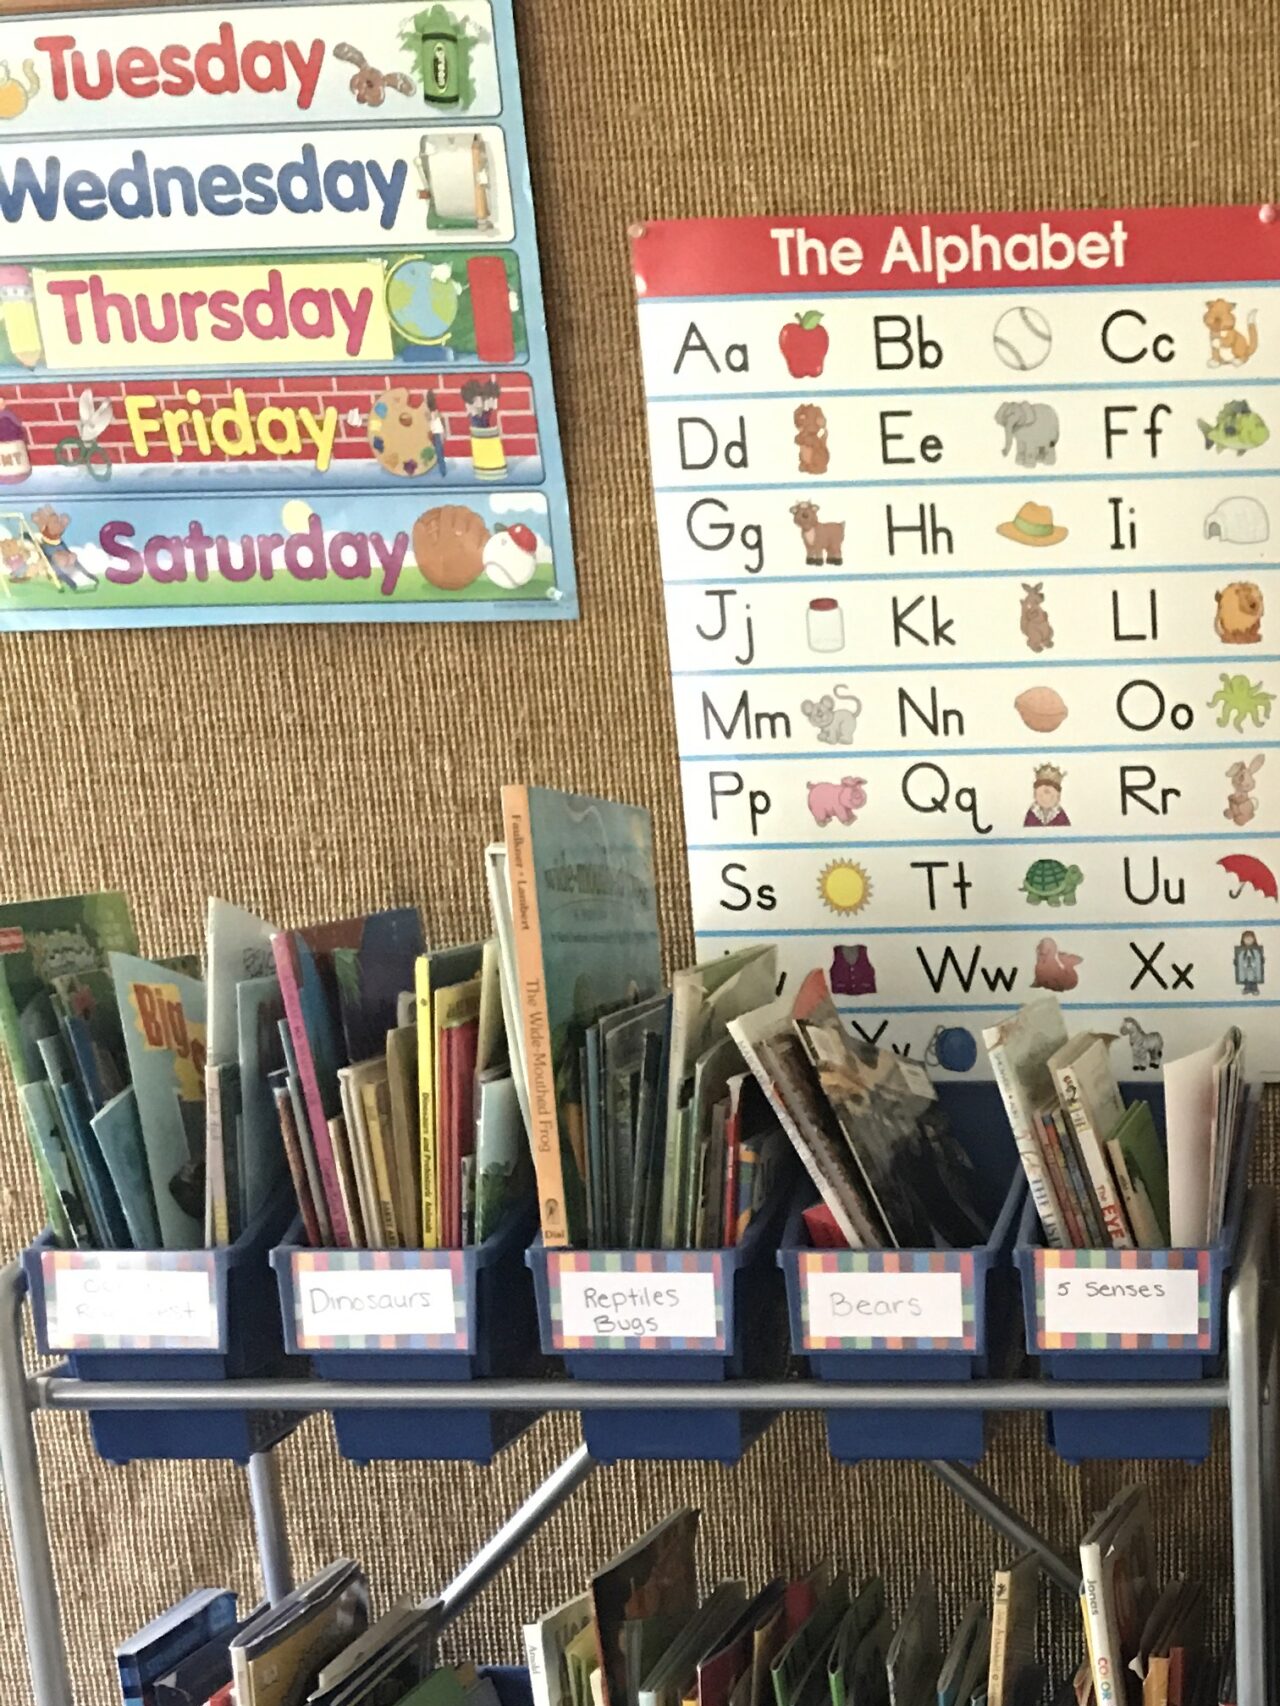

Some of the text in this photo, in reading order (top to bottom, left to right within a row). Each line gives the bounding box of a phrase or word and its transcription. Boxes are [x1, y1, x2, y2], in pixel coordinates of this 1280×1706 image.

[34, 22, 325, 109] Tuesday
[0, 143, 408, 230] Wednesday
[771, 220, 1128, 282] The Alphabet
[47, 269, 373, 357] Thursday
[123, 387, 337, 472] Friday
[100, 512, 409, 596] Saturday
[509, 813, 533, 930] Faulkner Lambert
[524, 978, 555, 1153] The Wide-Mouthed Frog
[309, 1288, 432, 1315] Dinosaurs
[584, 1287, 680, 1312] Reptiles
[593, 1313, 660, 1336] Bugs
[829, 1291, 922, 1317] Bears
[1057, 1280, 1167, 1299] 5 Senses
[1084, 1577, 1101, 1615] Jonas
